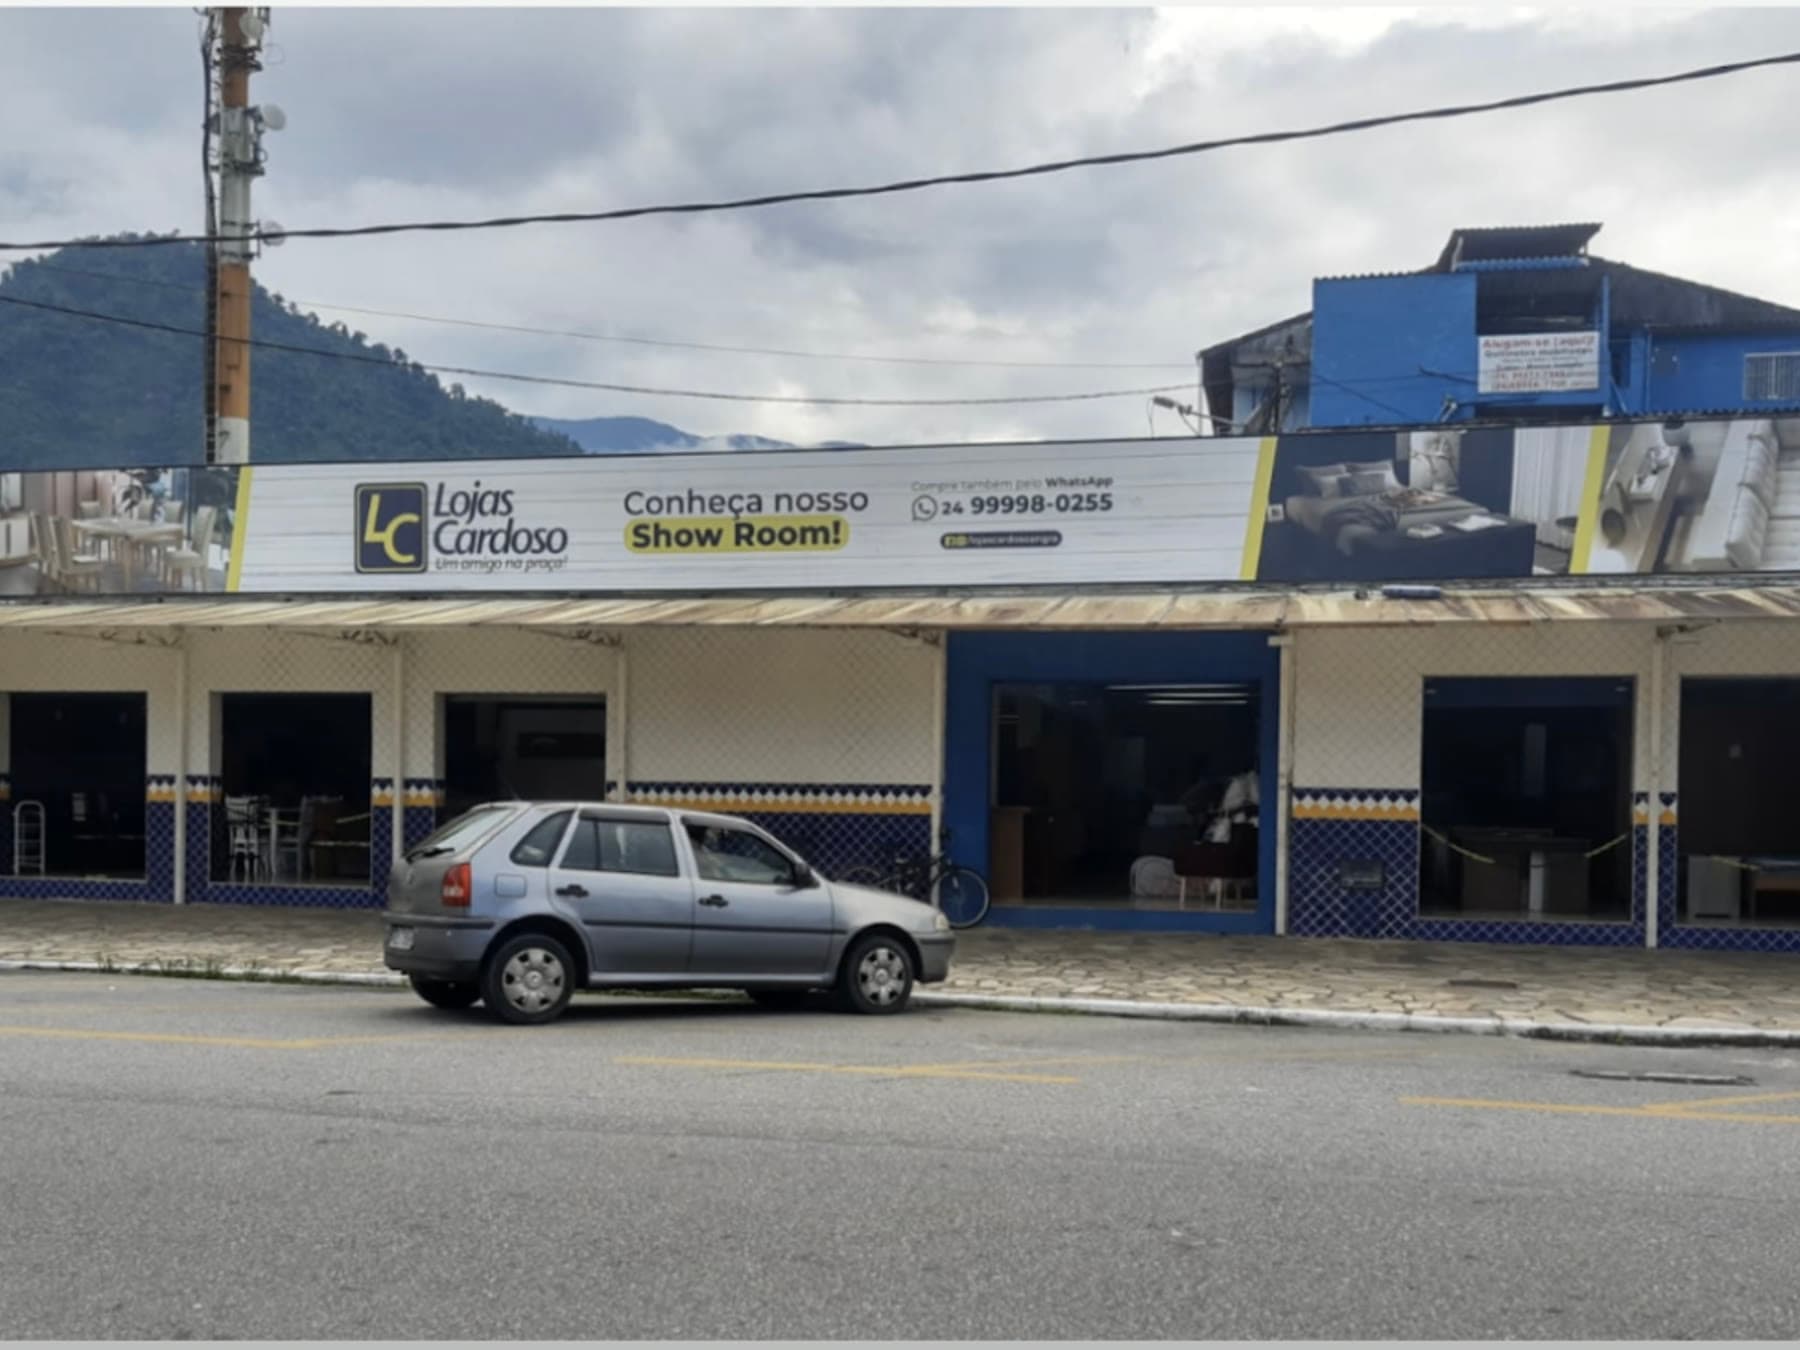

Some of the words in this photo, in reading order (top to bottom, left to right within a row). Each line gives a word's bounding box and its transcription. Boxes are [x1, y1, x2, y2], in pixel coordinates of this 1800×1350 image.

[1045, 476, 1114, 489] WhatsApp
[433, 480, 514, 524] Lojas
[624, 488, 763, 520] Conheça
[774, 491, 870, 512] nosso
[942, 501, 964, 515] 24
[971, 493, 1113, 514] 99998-0255
[364, 493, 419, 563] LC
[433, 518, 568, 554] Cardoso
[632, 523, 723, 548] Show
[734, 521, 841, 547] Room!
[436, 557, 458, 570] Um
[461, 557, 502, 573] amigo
[506, 559, 522, 570] na
